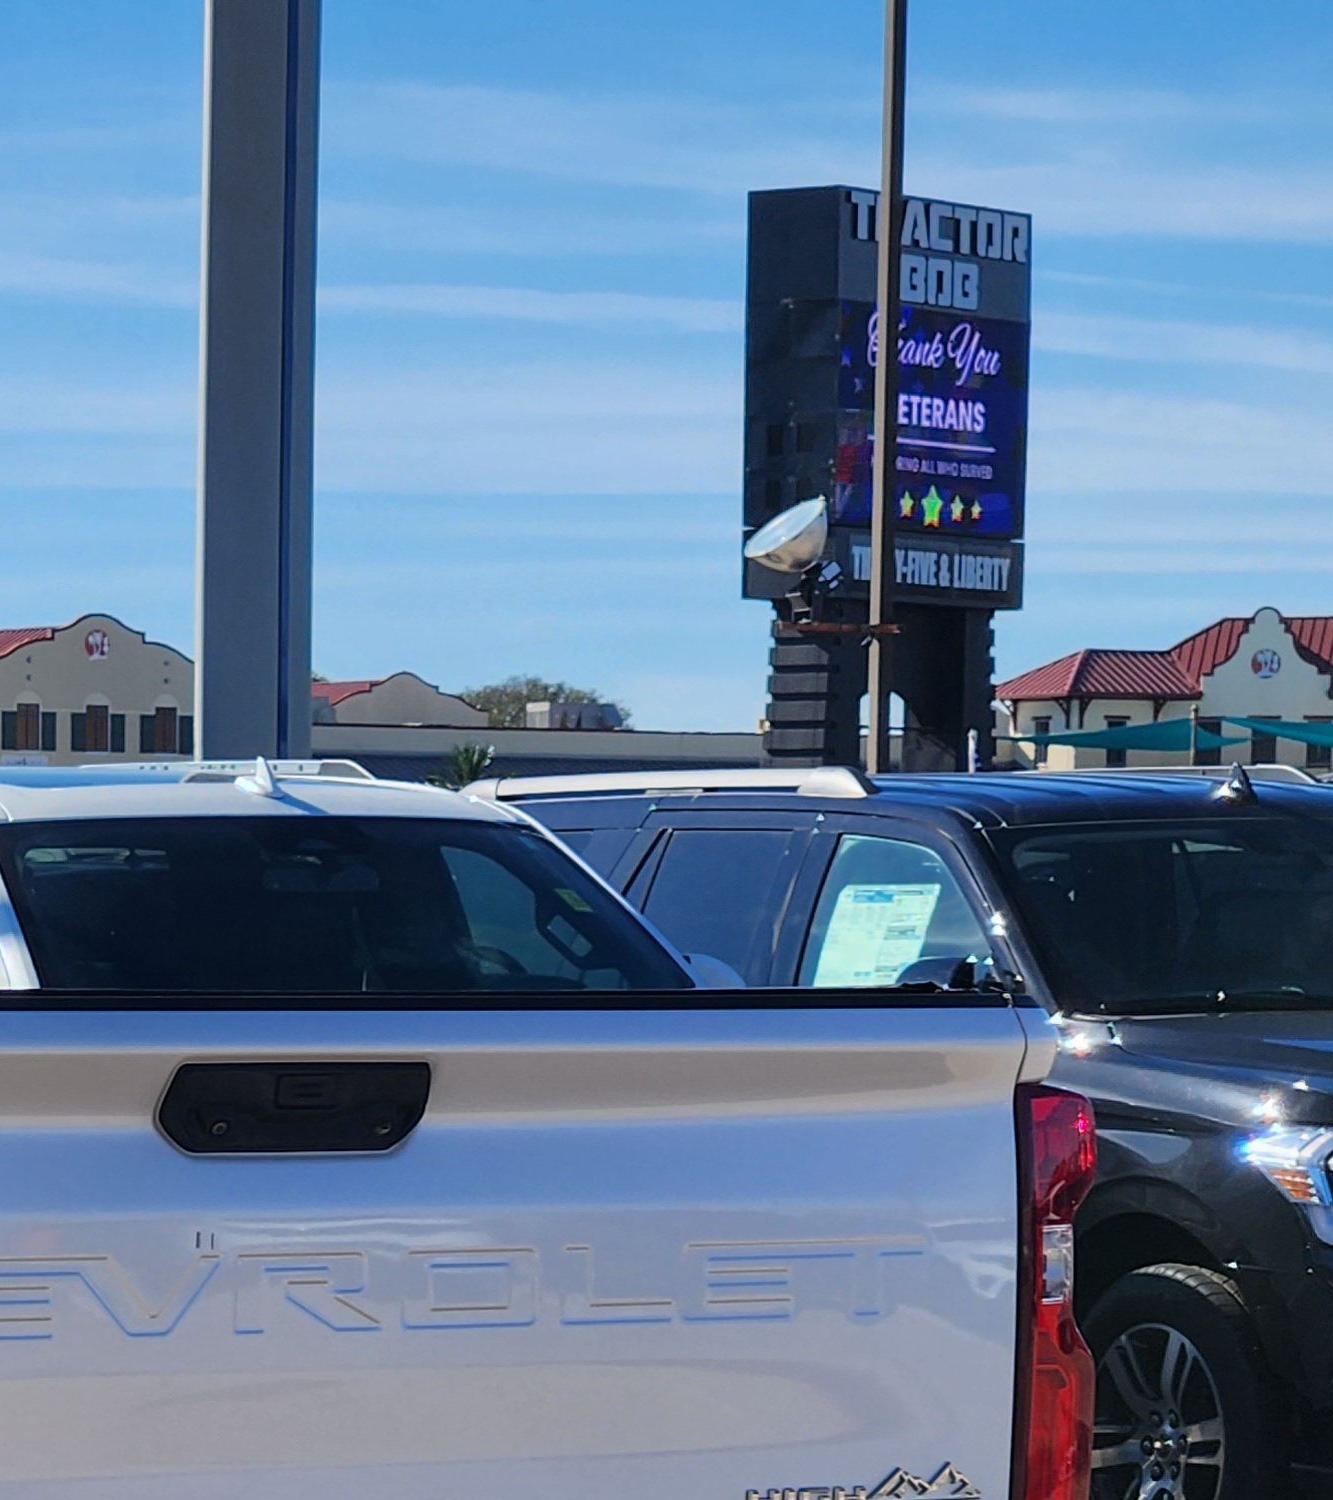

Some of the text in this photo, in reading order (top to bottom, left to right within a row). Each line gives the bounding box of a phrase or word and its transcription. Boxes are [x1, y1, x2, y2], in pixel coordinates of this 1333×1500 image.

[851, 190, 1028, 263] TACTOR
[899, 253, 979, 311] BOB
[946, 322, 1002, 387] You
[896, 393, 986, 433] ETERANS
[939, 553, 951, 588] &
[953, 553, 1011, 592] LIBERTY
